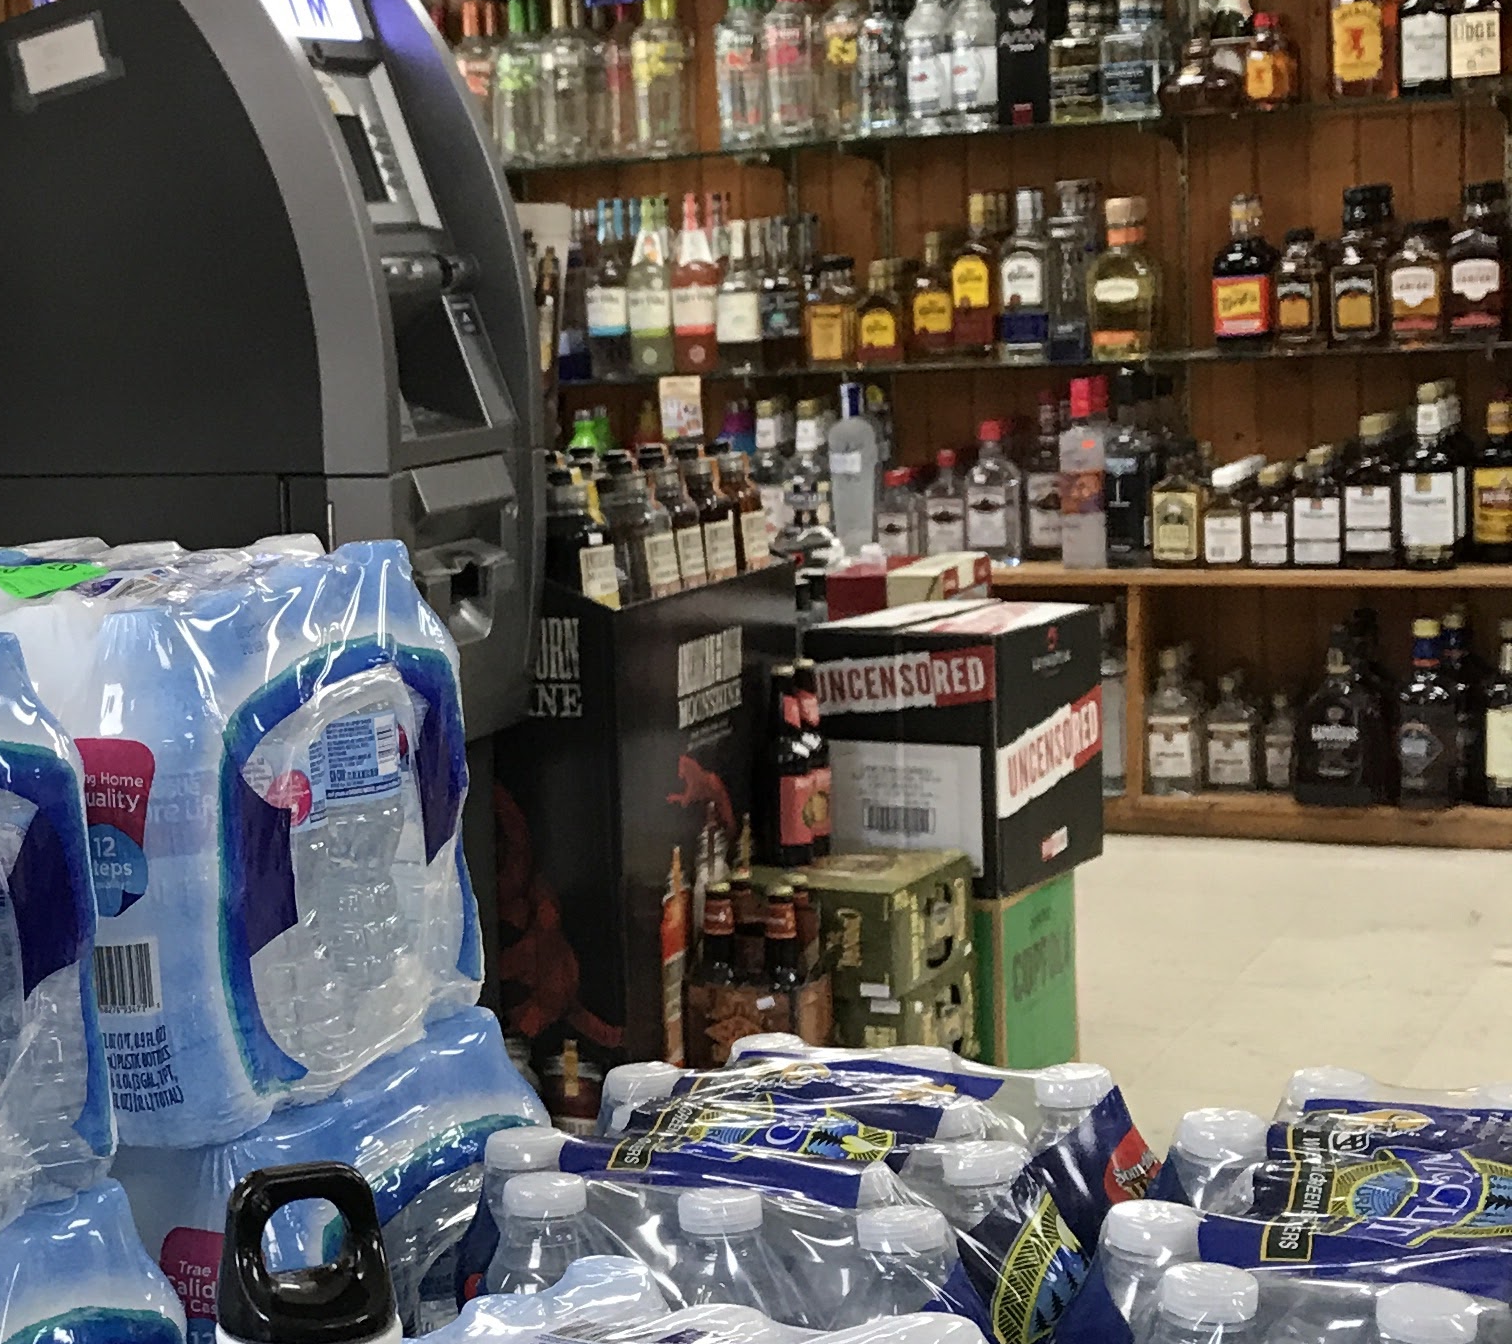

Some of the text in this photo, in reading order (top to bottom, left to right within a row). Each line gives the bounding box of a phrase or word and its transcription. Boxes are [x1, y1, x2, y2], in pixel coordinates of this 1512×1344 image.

[817, 654, 986, 705] UNCENSORED
[1005, 699, 1100, 798] UNCENSORED
[100, 771, 144, 789] Home
[87, 789, 141, 814] uality
[93, 836, 117, 858] 12
[93, 857, 134, 879] teps
[178, 1259, 213, 1278] Trae
